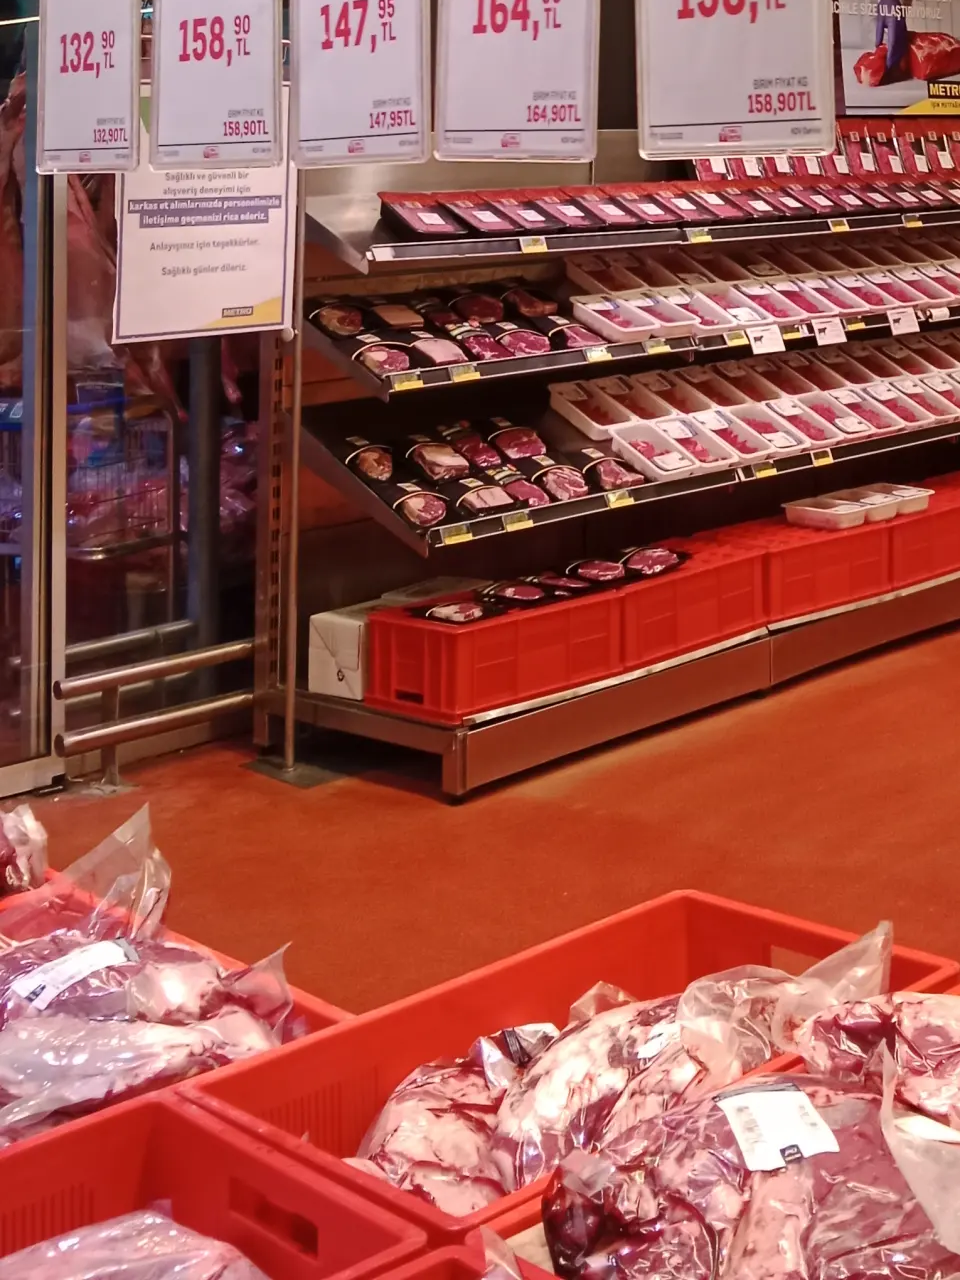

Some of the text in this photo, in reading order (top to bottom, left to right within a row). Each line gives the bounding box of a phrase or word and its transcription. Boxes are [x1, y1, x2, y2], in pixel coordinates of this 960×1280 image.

[544, 8, 562, 29] TL
[381, 22, 397, 41] TL
[236, 38, 252, 56] TL
[104, 52, 114, 69] TL
[748, 91, 816, 116] 158,90TL
[370, 110, 416, 130] 147,95TL
[526, 104, 581, 126] 164,90TL
[93, 128, 128, 144] 132,90TL
[223, 120, 269, 138] 158,90TL
